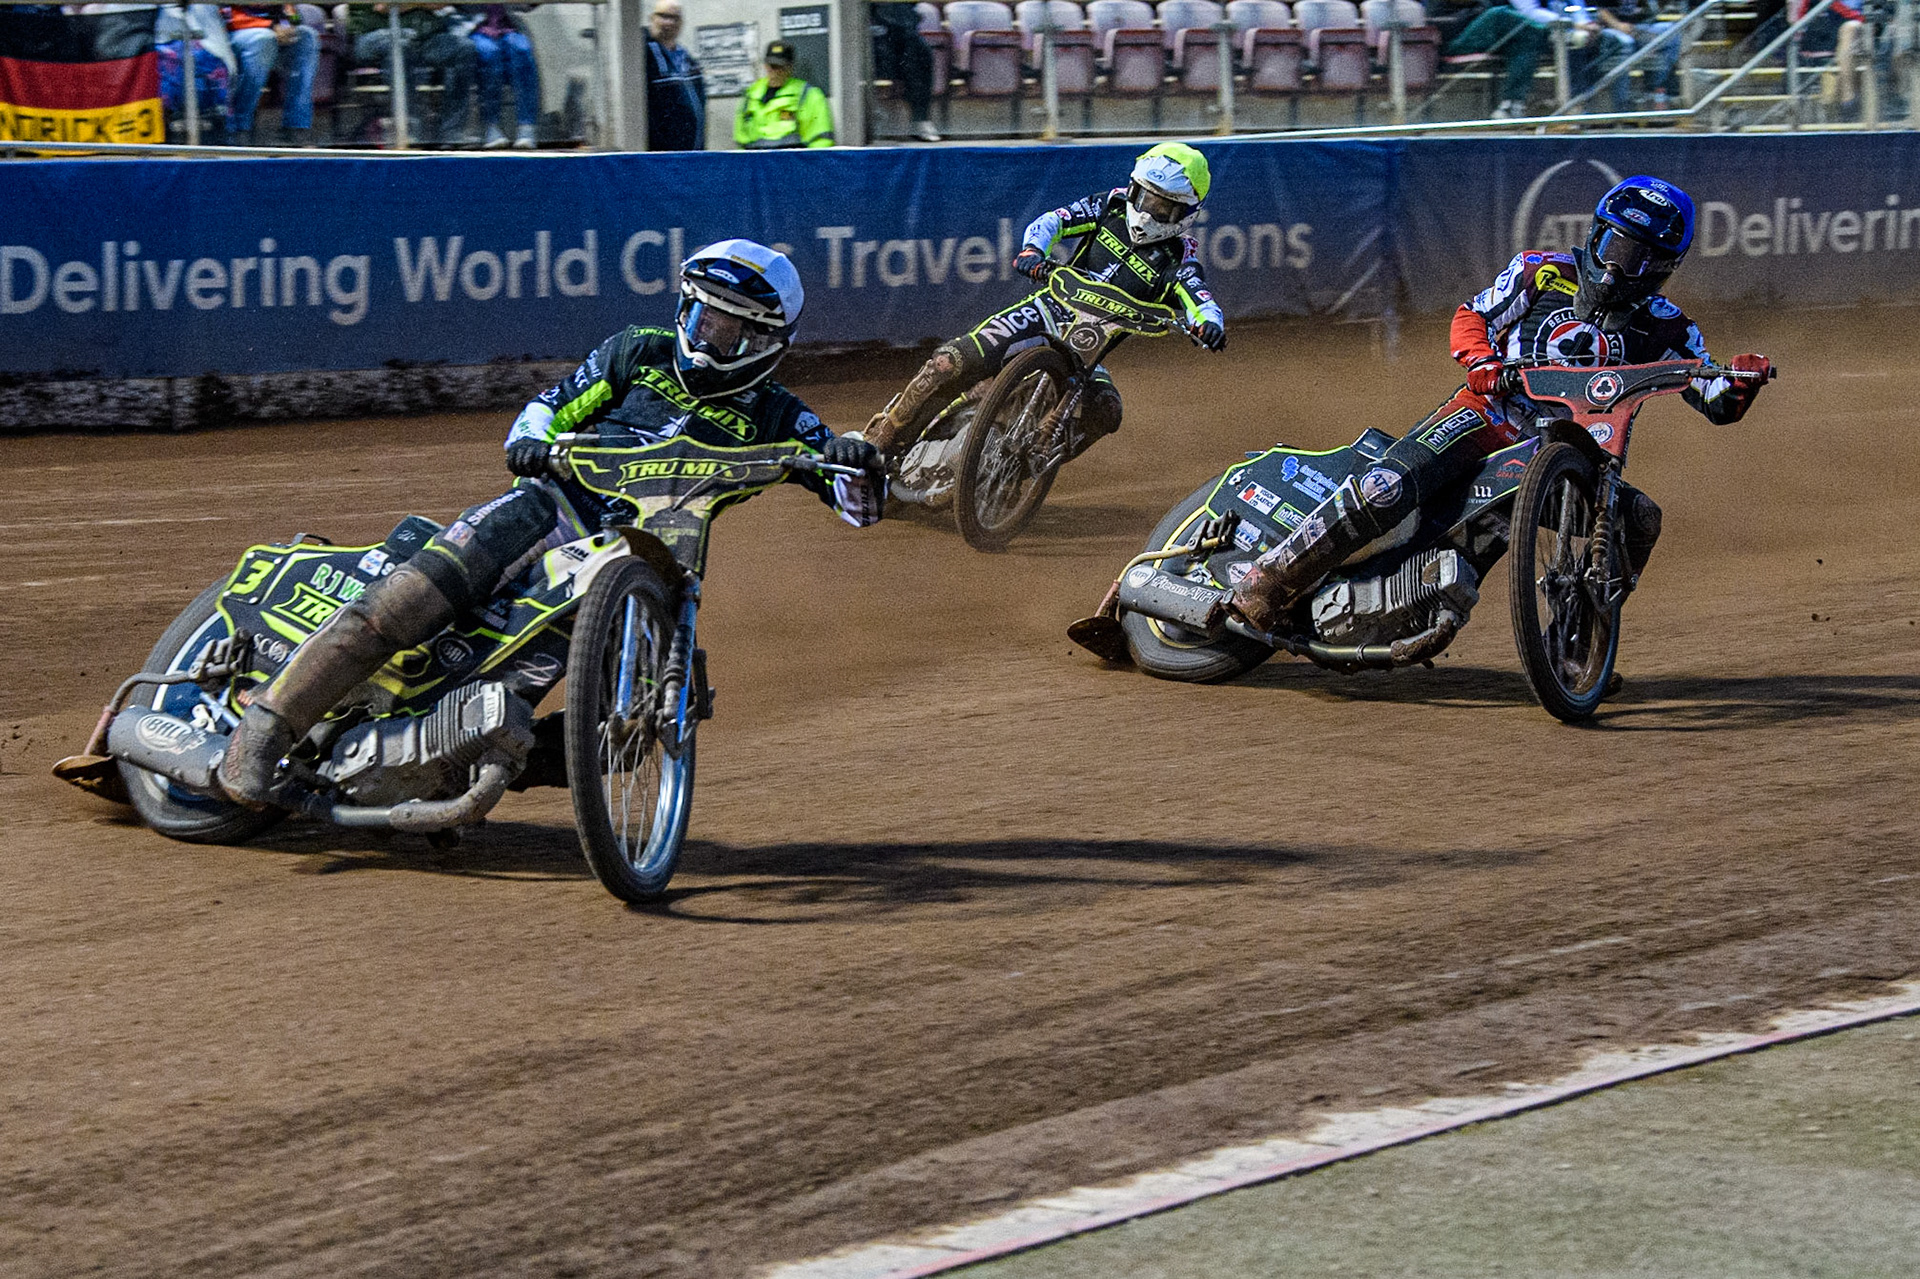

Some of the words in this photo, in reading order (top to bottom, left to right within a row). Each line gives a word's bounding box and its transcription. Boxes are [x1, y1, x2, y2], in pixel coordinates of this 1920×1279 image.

[815, 217, 1013, 290] Travel
[1127, 254, 1157, 282] MIX
[0, 237, 371, 326] Delivering
[394, 229, 598, 302] World
[1078, 291, 1107, 307] TRU
[1105, 301, 1139, 319] MIX
[1547, 311, 1579, 328] BELL
[643, 369, 691, 402] TRU
[698, 404, 749, 437] MIX
[627, 461, 679, 479] TRU
[680, 461, 734, 479] MIX
[229, 559, 276, 596] 3
[1150, 575, 1220, 604] #teamATPI
[290, 594, 337, 624] TR
